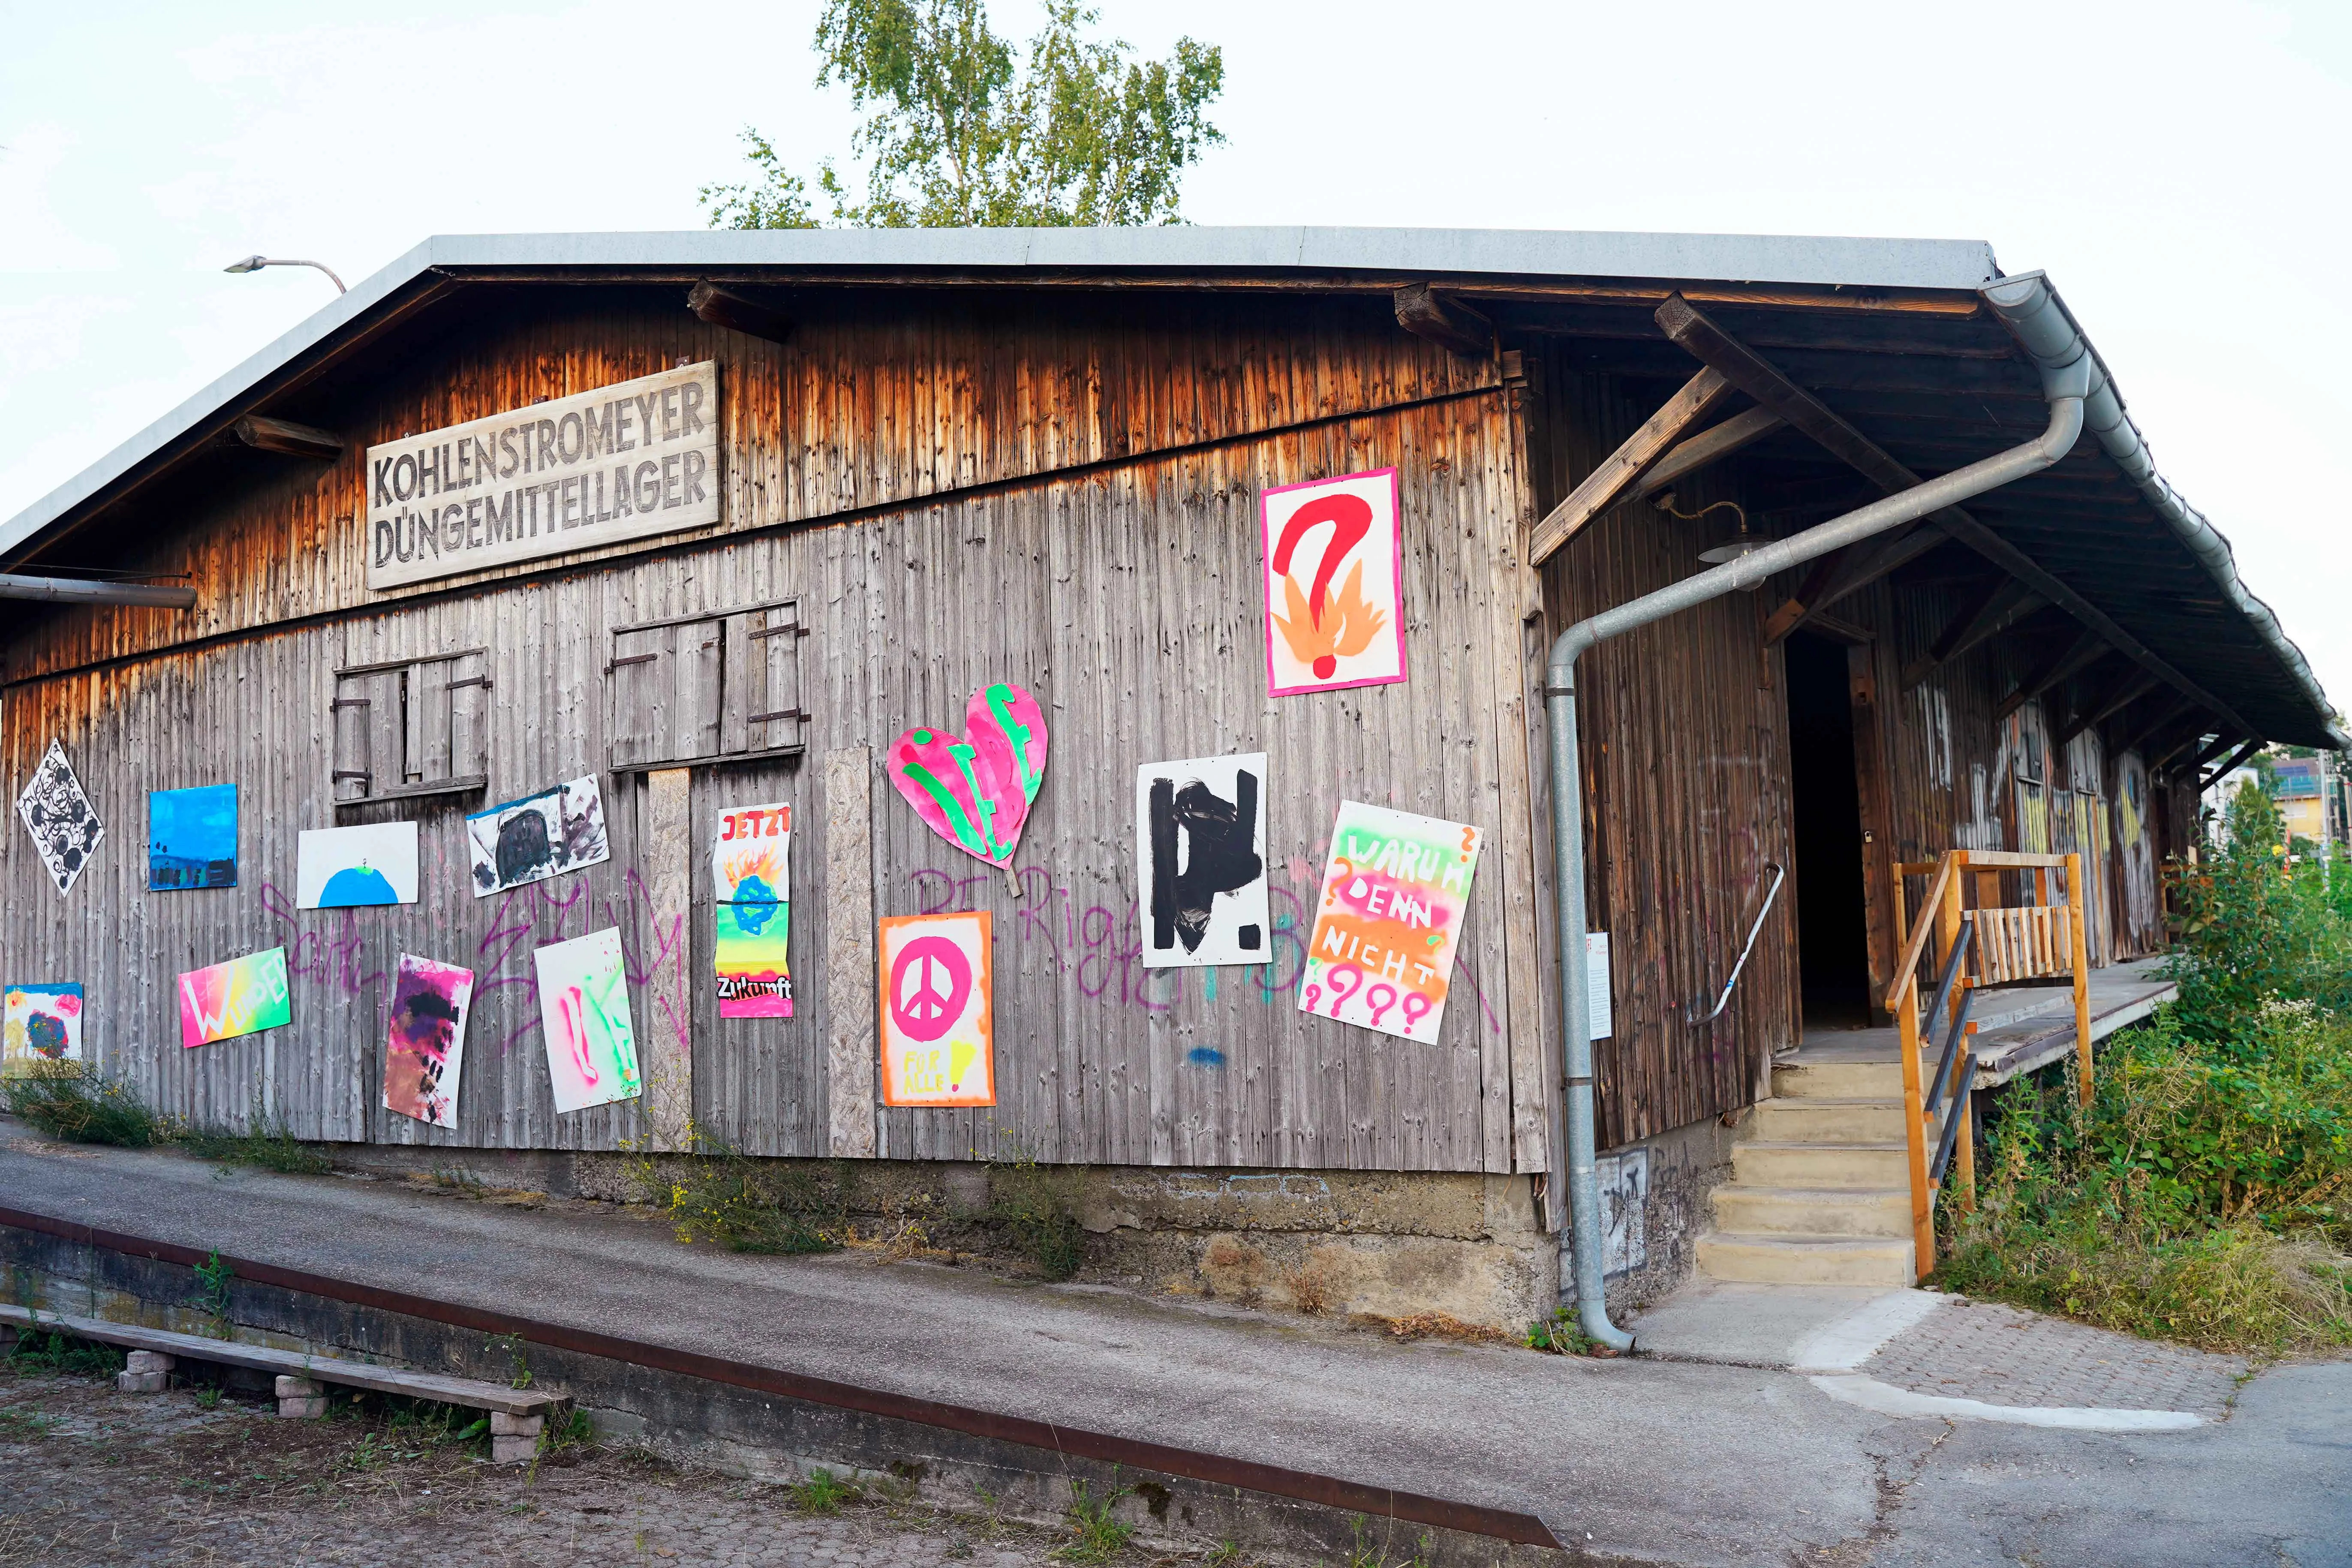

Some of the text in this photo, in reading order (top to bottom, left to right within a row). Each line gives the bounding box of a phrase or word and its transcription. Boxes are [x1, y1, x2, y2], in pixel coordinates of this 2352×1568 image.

[374, 382, 705, 509] KOHLENSTROMEYER
[375, 450, 706, 569] DÜNGEMITTELLAGER
[722, 806, 791, 841] JETZT
[1348, 834, 1466, 893] WARUM
[1348, 877, 1432, 929] DENN
[1322, 925, 1436, 985] NICHT
[716, 976, 791, 1001] Zukunft
[903, 1050, 940, 1074] FÜR
[904, 1073, 944, 1095] ALLE
